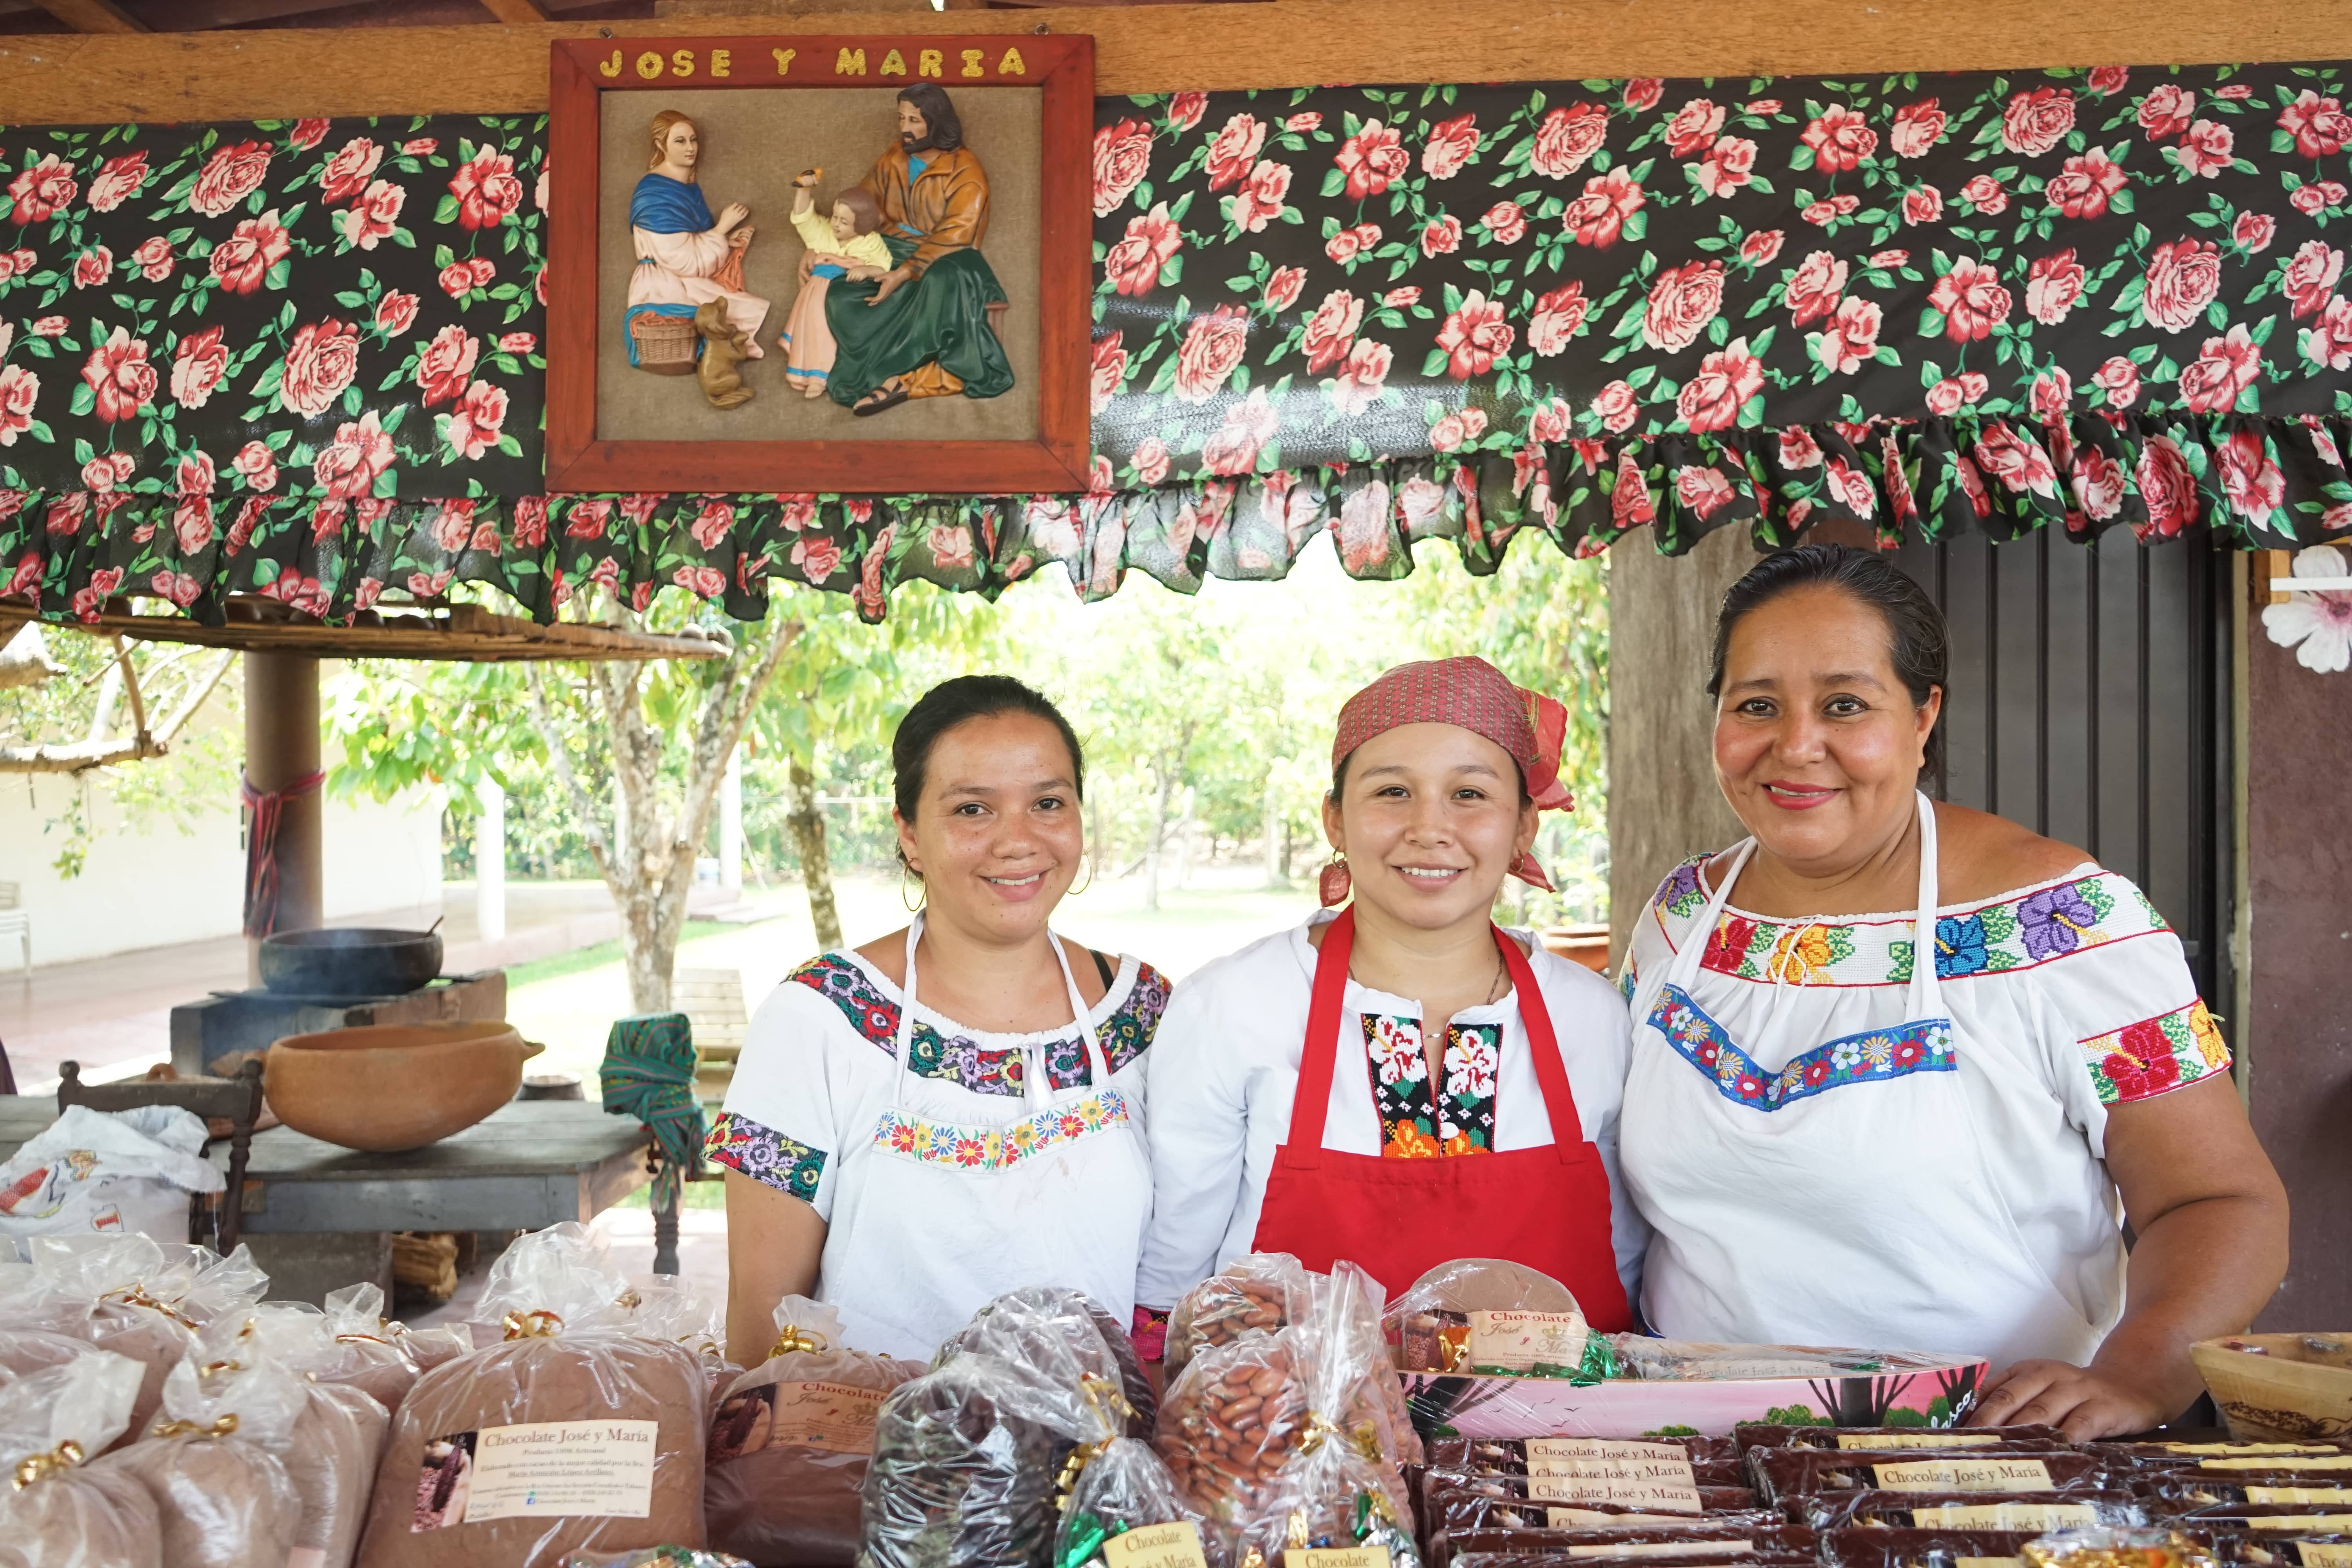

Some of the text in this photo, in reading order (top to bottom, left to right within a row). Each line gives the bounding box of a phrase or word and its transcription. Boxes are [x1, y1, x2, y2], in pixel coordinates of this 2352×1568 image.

[599, 47, 1026, 79] JOSE Y MARIA
[1491, 1312, 1571, 1323] Chocolate
[1481, 1322, 1523, 1336] José
[1519, 1336, 1531, 1345] y
[1698, 1366, 1748, 1377] hocolate
[485, 1428, 649, 1447] Chocolate José y María
[1534, 1445, 1681, 1461] Chocolate José y María
[1536, 1465, 1686, 1481] Chocolate José y María
[1884, 1465, 2042, 1485] Chocolate José y María
[1536, 1484, 1693, 1500] Chocolate José y María
[2037, 1521, 2045, 1531] y
[1125, 1528, 1183, 1552] Chocolate
[1163, 1553, 1197, 1568] María
[1305, 1552, 1370, 1568] Chocolate
